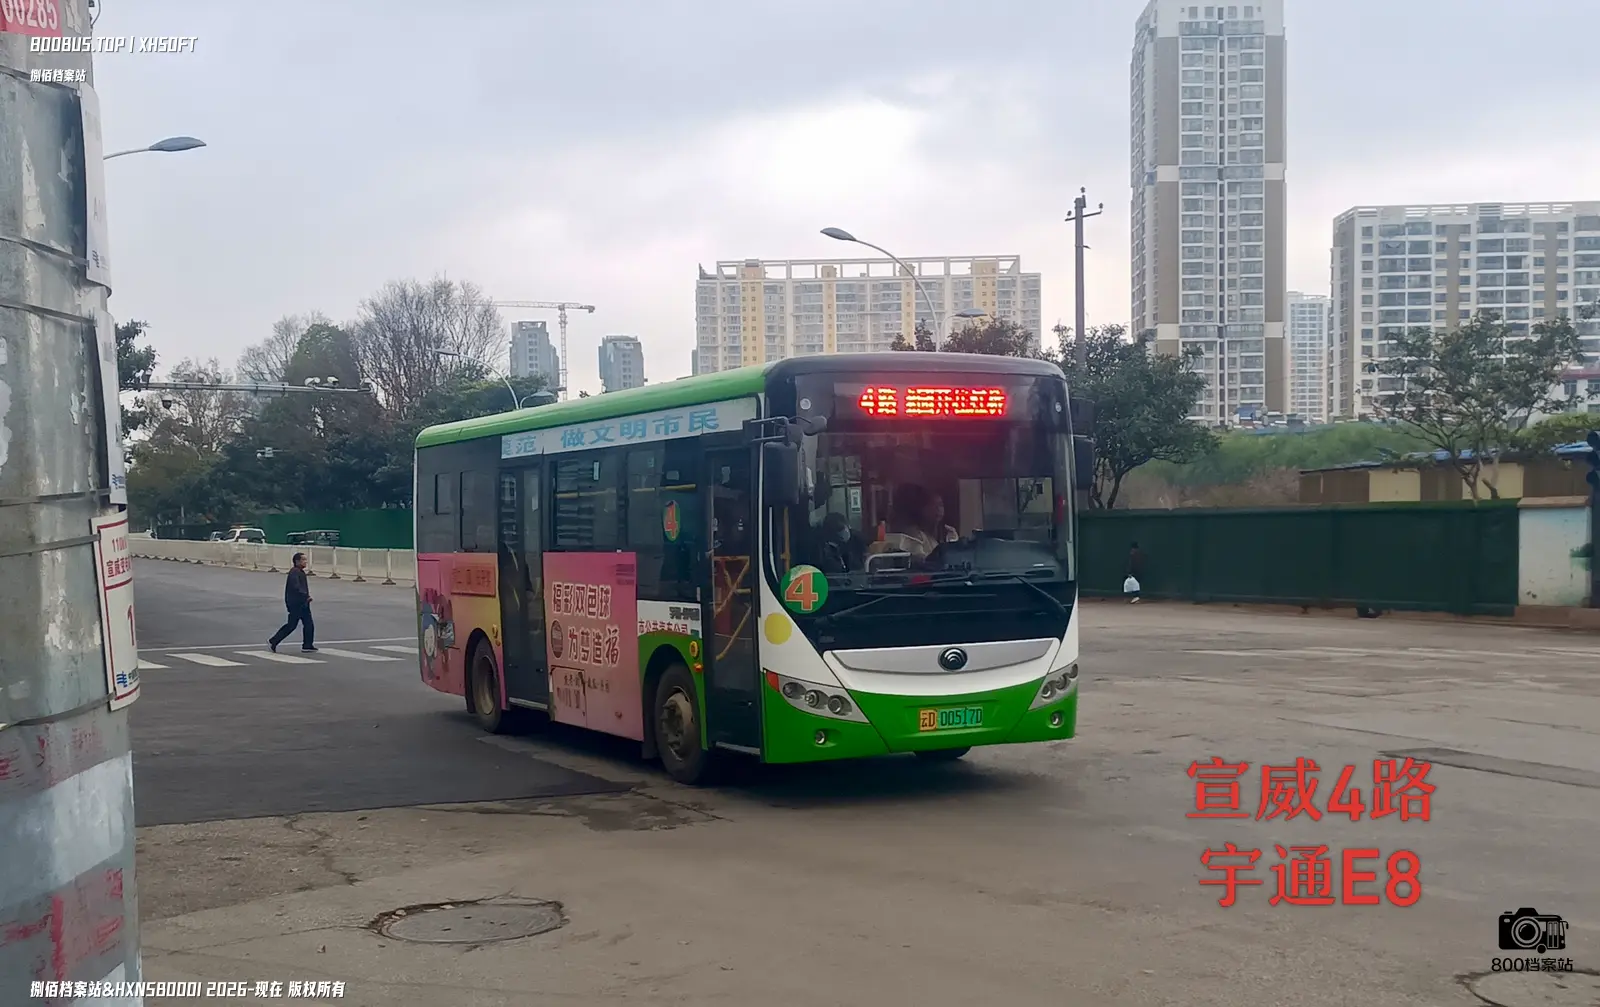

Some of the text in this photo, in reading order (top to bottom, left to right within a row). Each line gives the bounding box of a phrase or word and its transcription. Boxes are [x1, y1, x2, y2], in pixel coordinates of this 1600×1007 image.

[560, 408, 720, 449] 做文明市民
[664, 502, 678, 539] 4
[552, 582, 612, 619] 福彩双色球
[784, 571, 819, 611] 4
